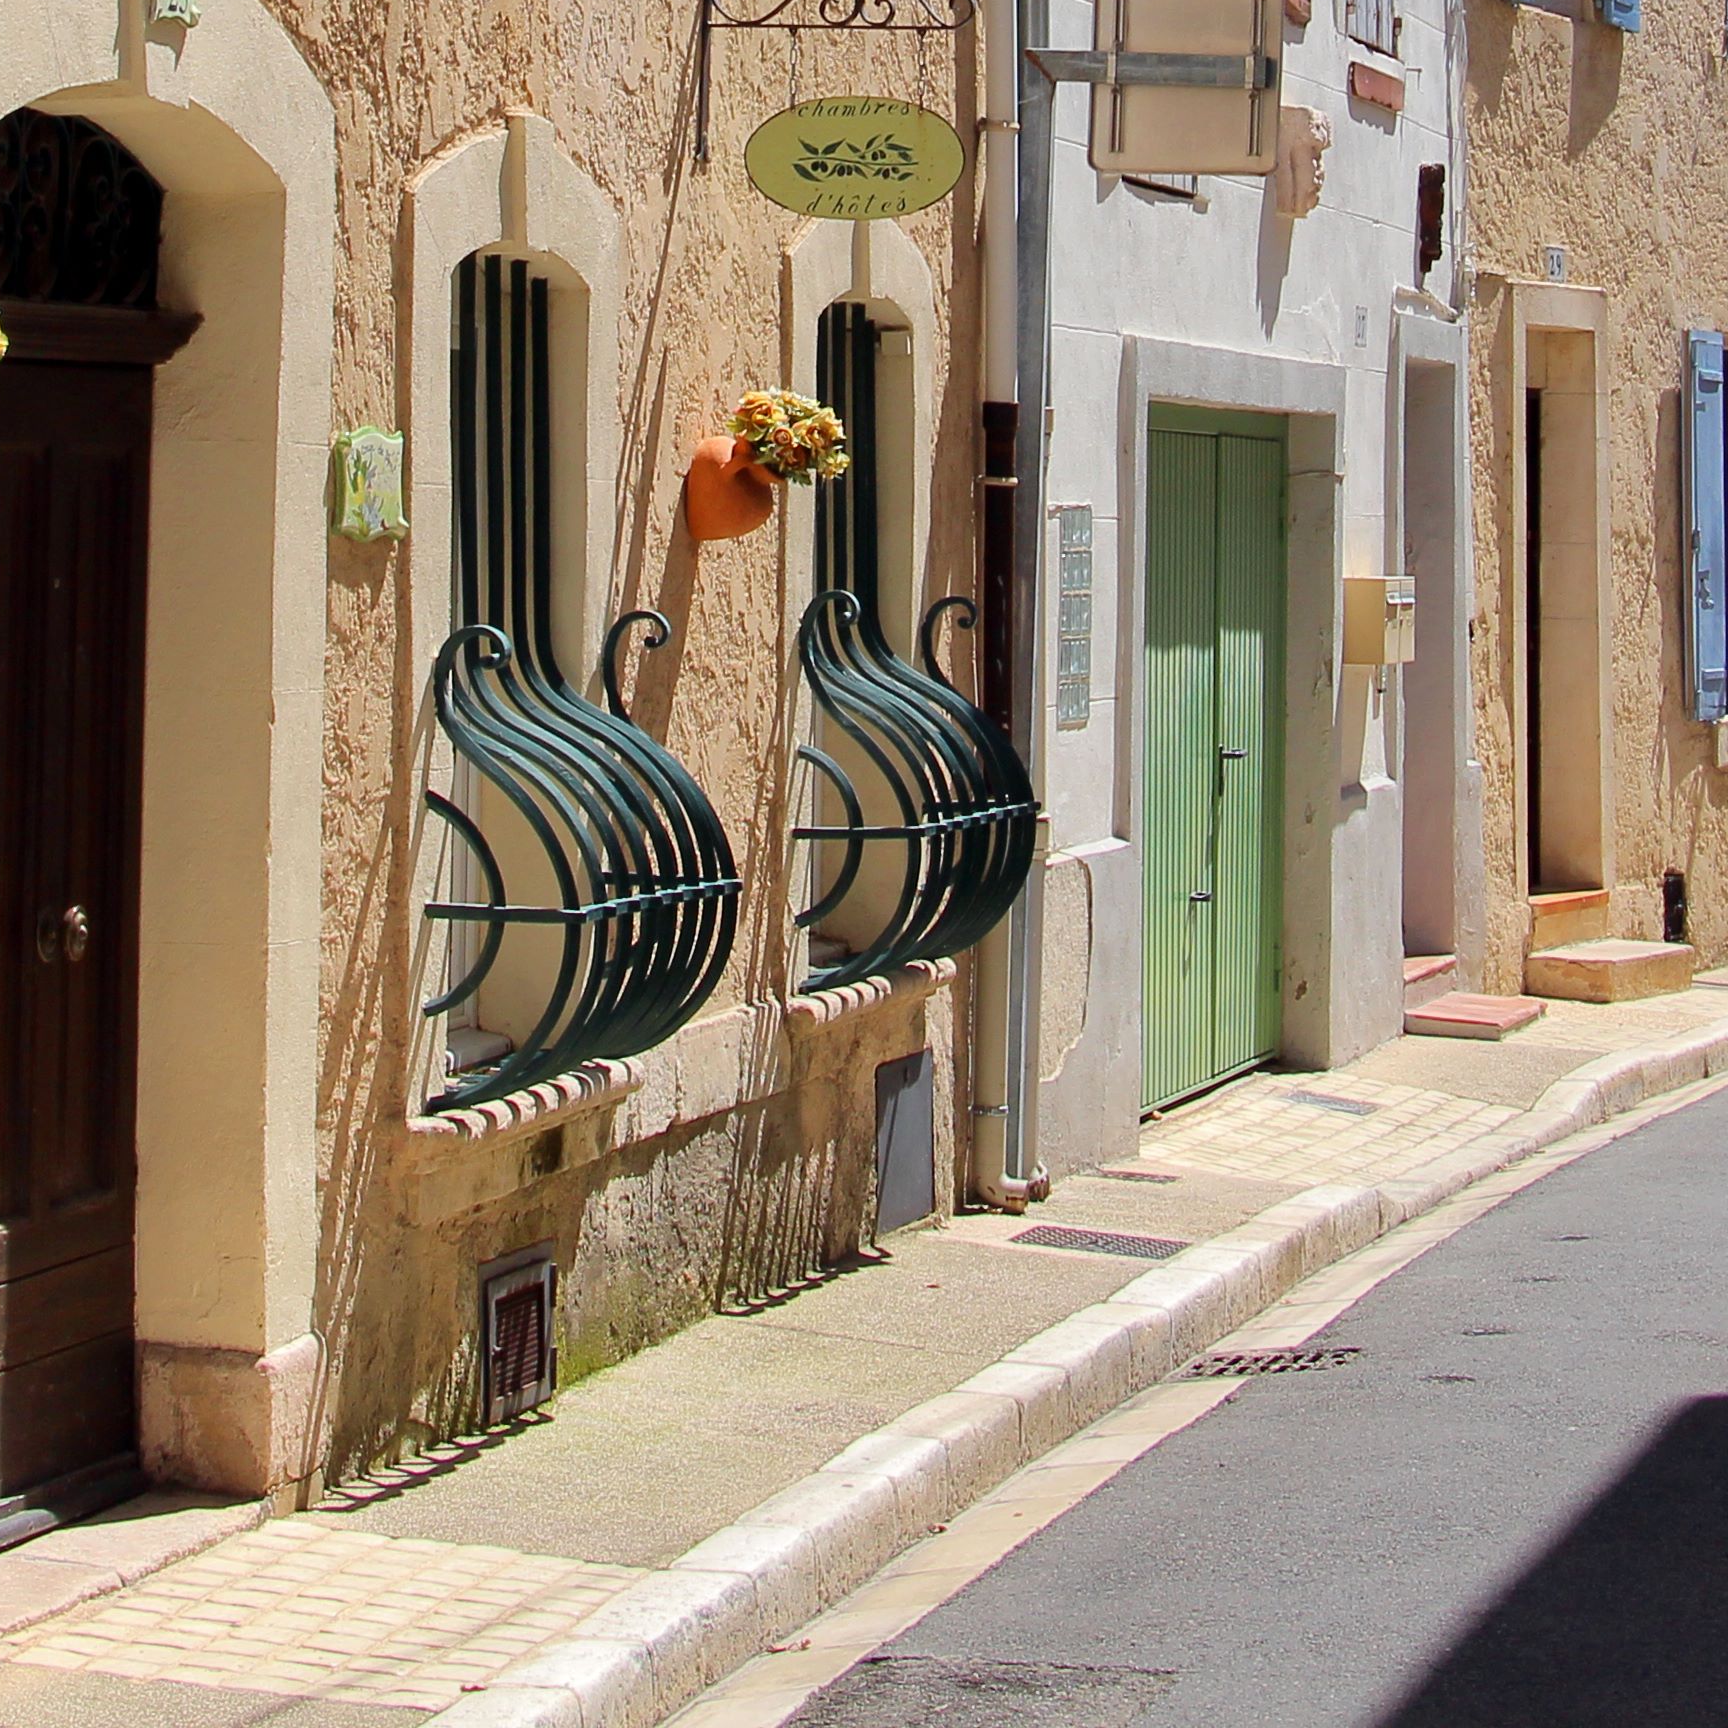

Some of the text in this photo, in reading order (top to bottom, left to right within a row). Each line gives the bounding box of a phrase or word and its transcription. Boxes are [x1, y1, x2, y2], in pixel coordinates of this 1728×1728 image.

[797, 97, 910, 118] chambres
[806, 194, 907, 214] d'hôtes
[1549, 253, 1562, 277] 29
